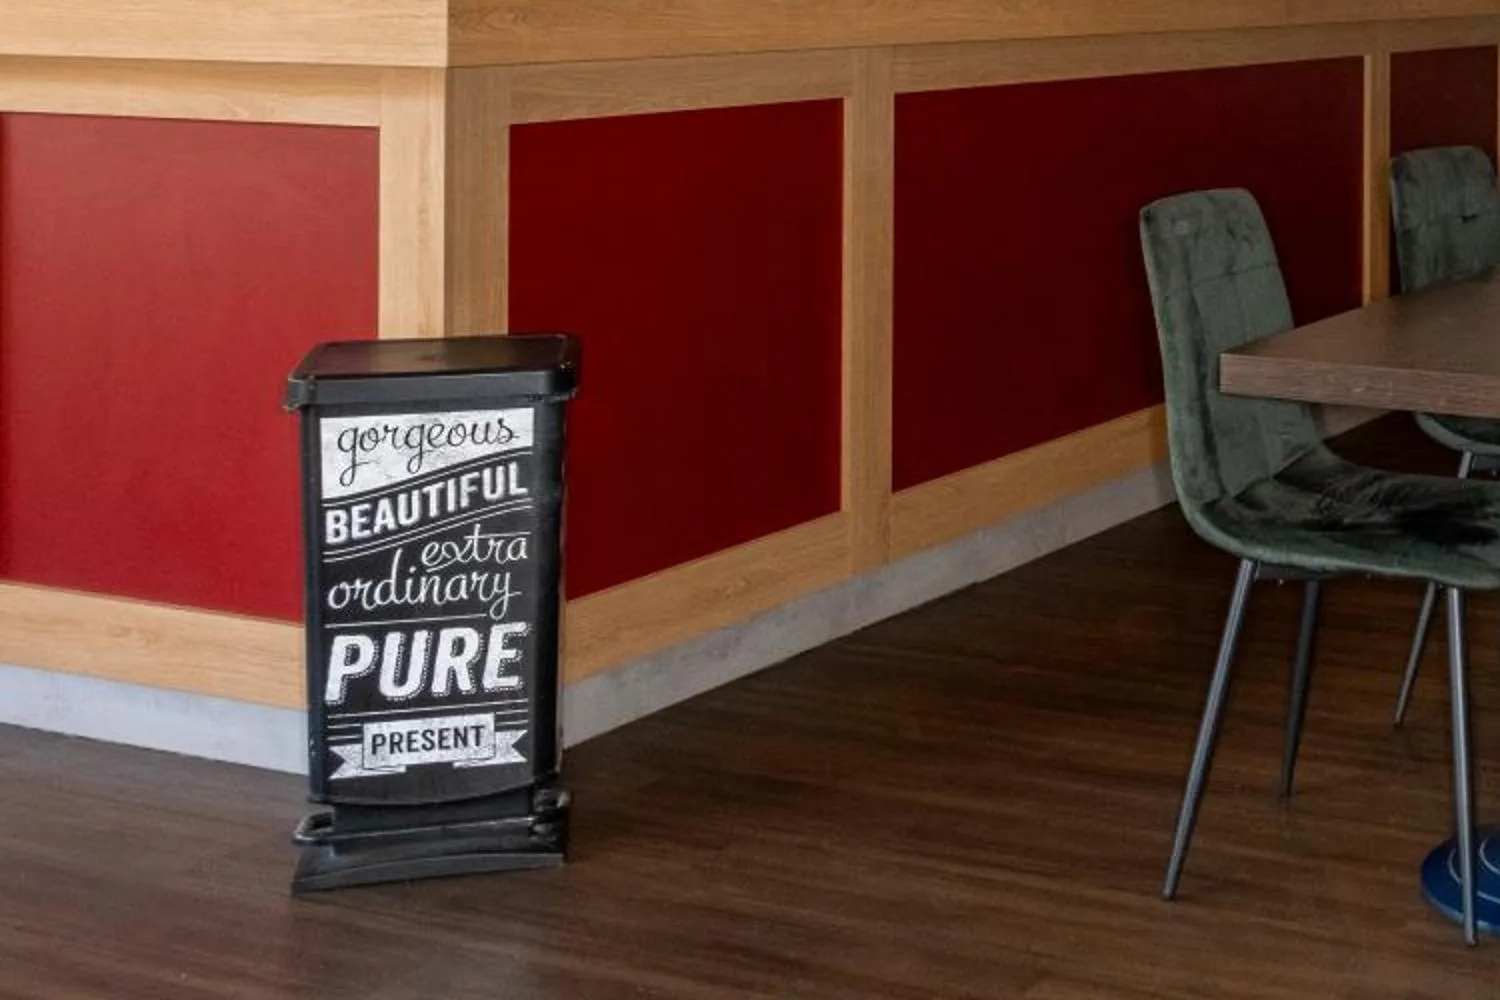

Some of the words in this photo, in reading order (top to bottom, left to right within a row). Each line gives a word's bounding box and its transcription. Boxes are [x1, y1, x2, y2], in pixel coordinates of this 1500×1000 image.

[337, 417, 520, 487] gorgeous
[325, 461, 528, 545] BEAUTIFUL
[421, 523, 531, 573] extra
[327, 548, 522, 620] ordinary
[324, 621, 531, 705] PURE
[371, 725, 486, 755] PRESENT
